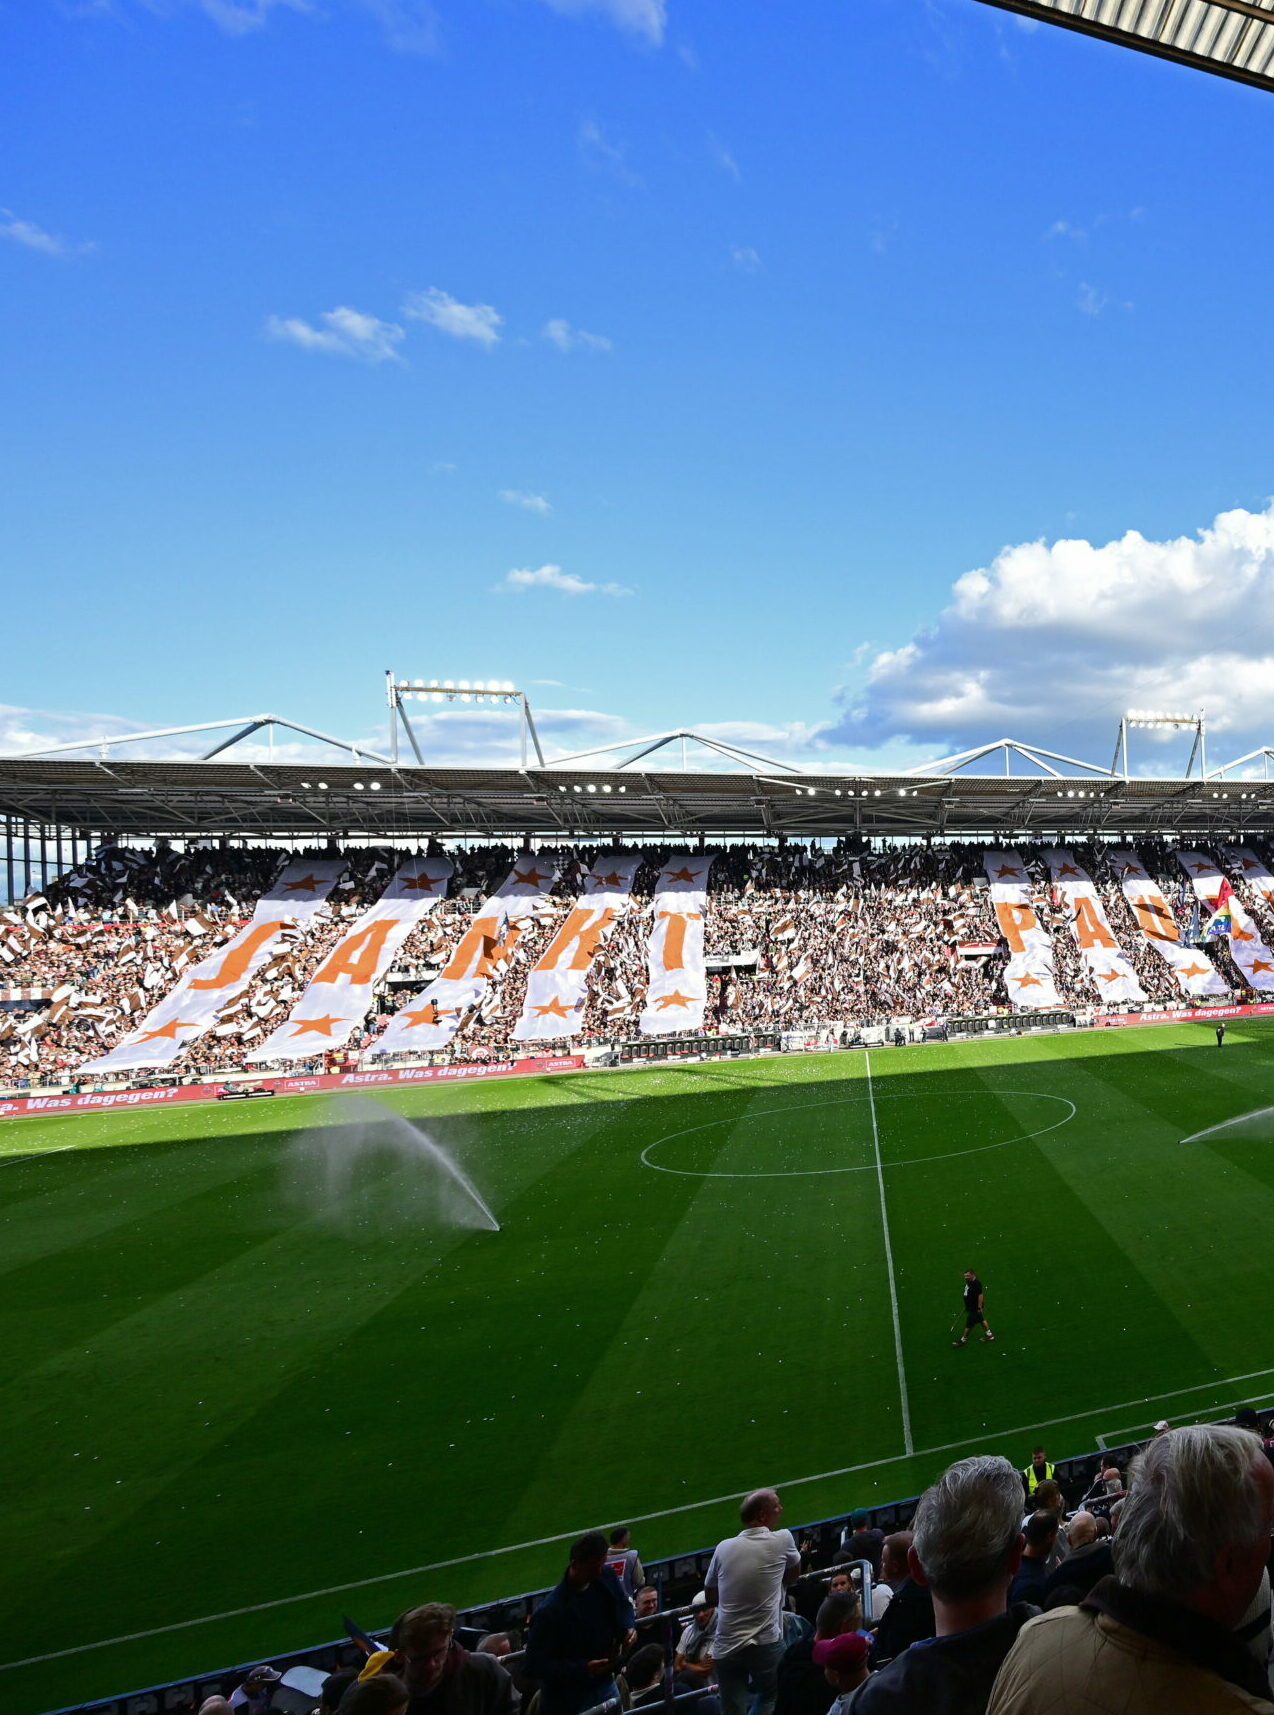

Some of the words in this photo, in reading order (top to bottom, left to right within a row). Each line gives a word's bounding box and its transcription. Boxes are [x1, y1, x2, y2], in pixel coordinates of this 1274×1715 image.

[1139, 1012, 1169, 1021] Astra.
[1172, 1010, 1192, 1019] Was
[1194, 1006, 1242, 1018] dagegen?
[341, 1072, 393, 1084] Astra.
[399, 1069, 433, 1079] Was
[437, 1062, 517, 1077] dagegen?
[287, 1079, 317, 1088] ASTRA
[26, 1097, 72, 1110] Was
[77, 1088, 179, 1106] dagegen?
